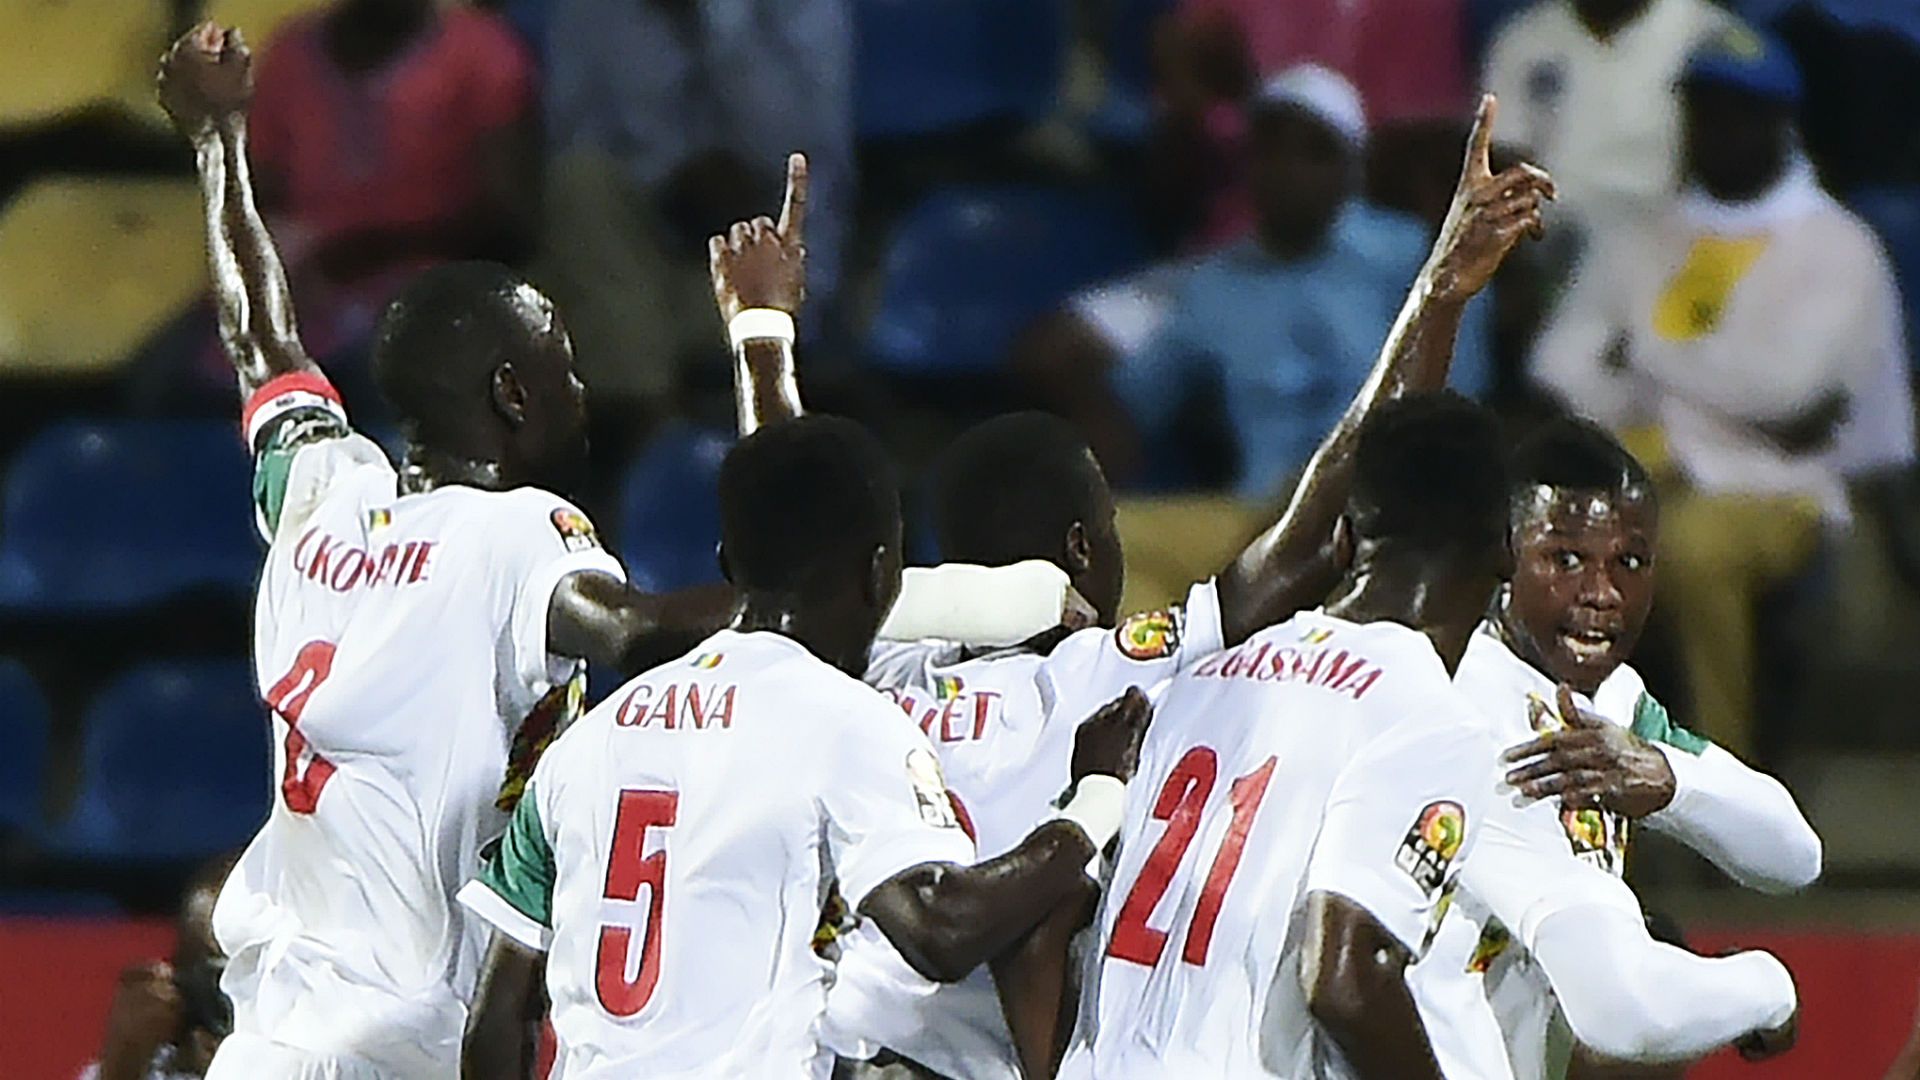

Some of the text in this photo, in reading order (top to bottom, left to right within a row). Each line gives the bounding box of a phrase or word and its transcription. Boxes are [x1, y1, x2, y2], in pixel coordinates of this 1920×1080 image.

[617, 683, 737, 729] GANA
[596, 789, 679, 1017] 5
[1106, 745, 1278, 967] 21
